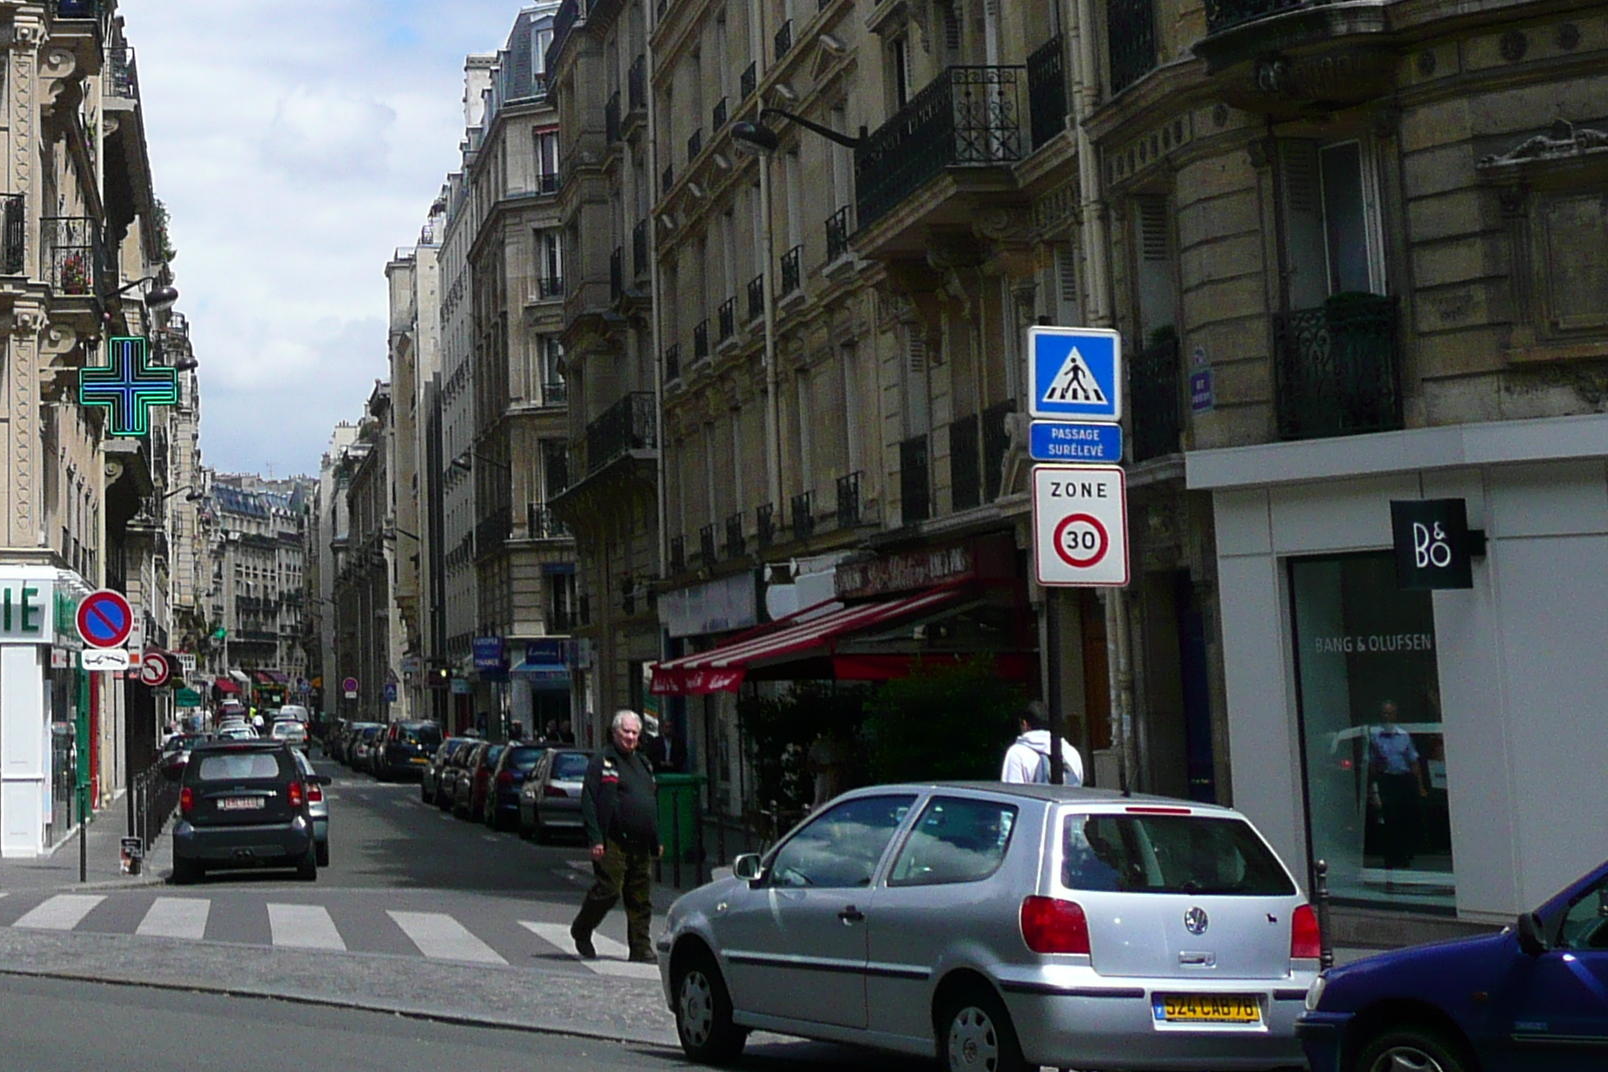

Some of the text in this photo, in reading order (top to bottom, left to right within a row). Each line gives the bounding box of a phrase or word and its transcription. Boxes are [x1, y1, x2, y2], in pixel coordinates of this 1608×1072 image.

[1052, 428, 1100, 441] PASSAGE
[1048, 443, 1104, 457] SURÉLEVÉ
[1051, 482, 1107, 498] ZONE
[1066, 531, 1096, 549] 30
[1315, 634, 1432, 653] BANG & OLUFSEN
[1200, 997, 1231, 1016] CAB
